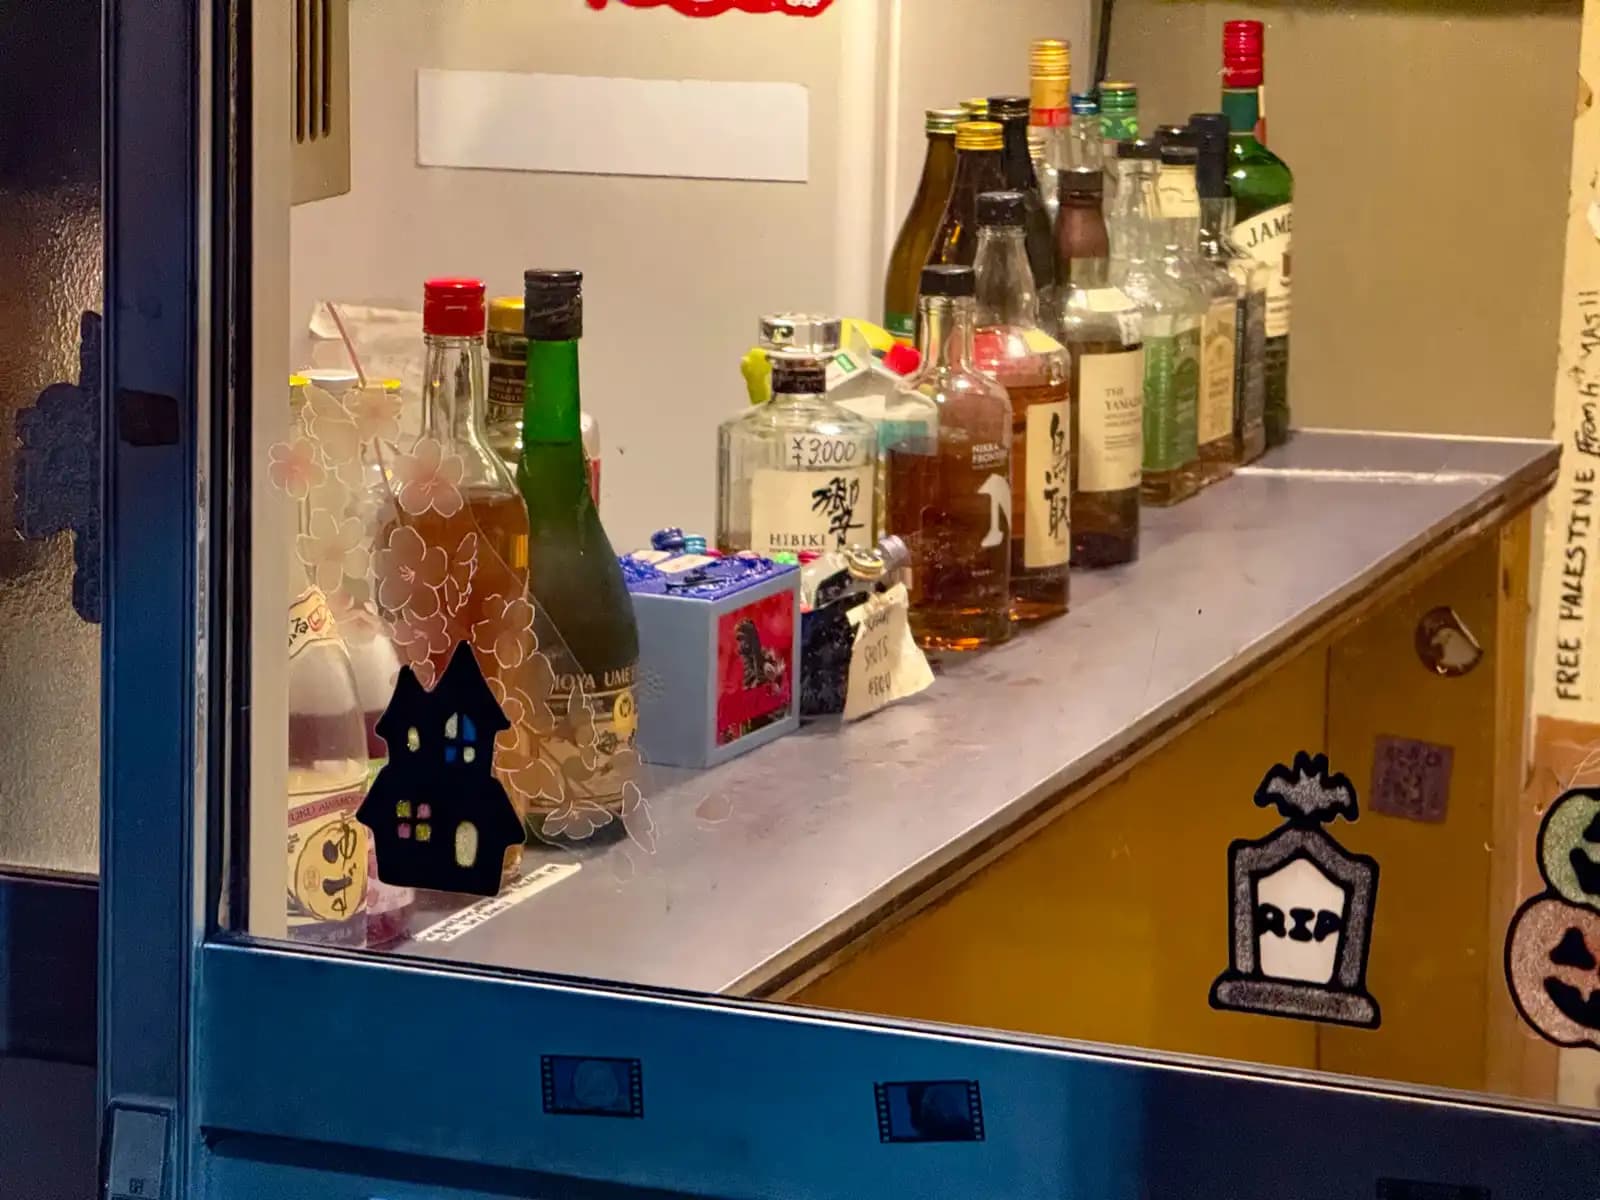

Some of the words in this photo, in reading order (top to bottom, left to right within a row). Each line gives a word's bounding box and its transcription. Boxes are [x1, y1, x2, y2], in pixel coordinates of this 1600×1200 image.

[769, 533, 826, 546] HIBIKI
[1560, 469, 1595, 621] PALESTINE
[1556, 637, 1582, 700] FREE
[1256, 903, 1342, 942] RIP
